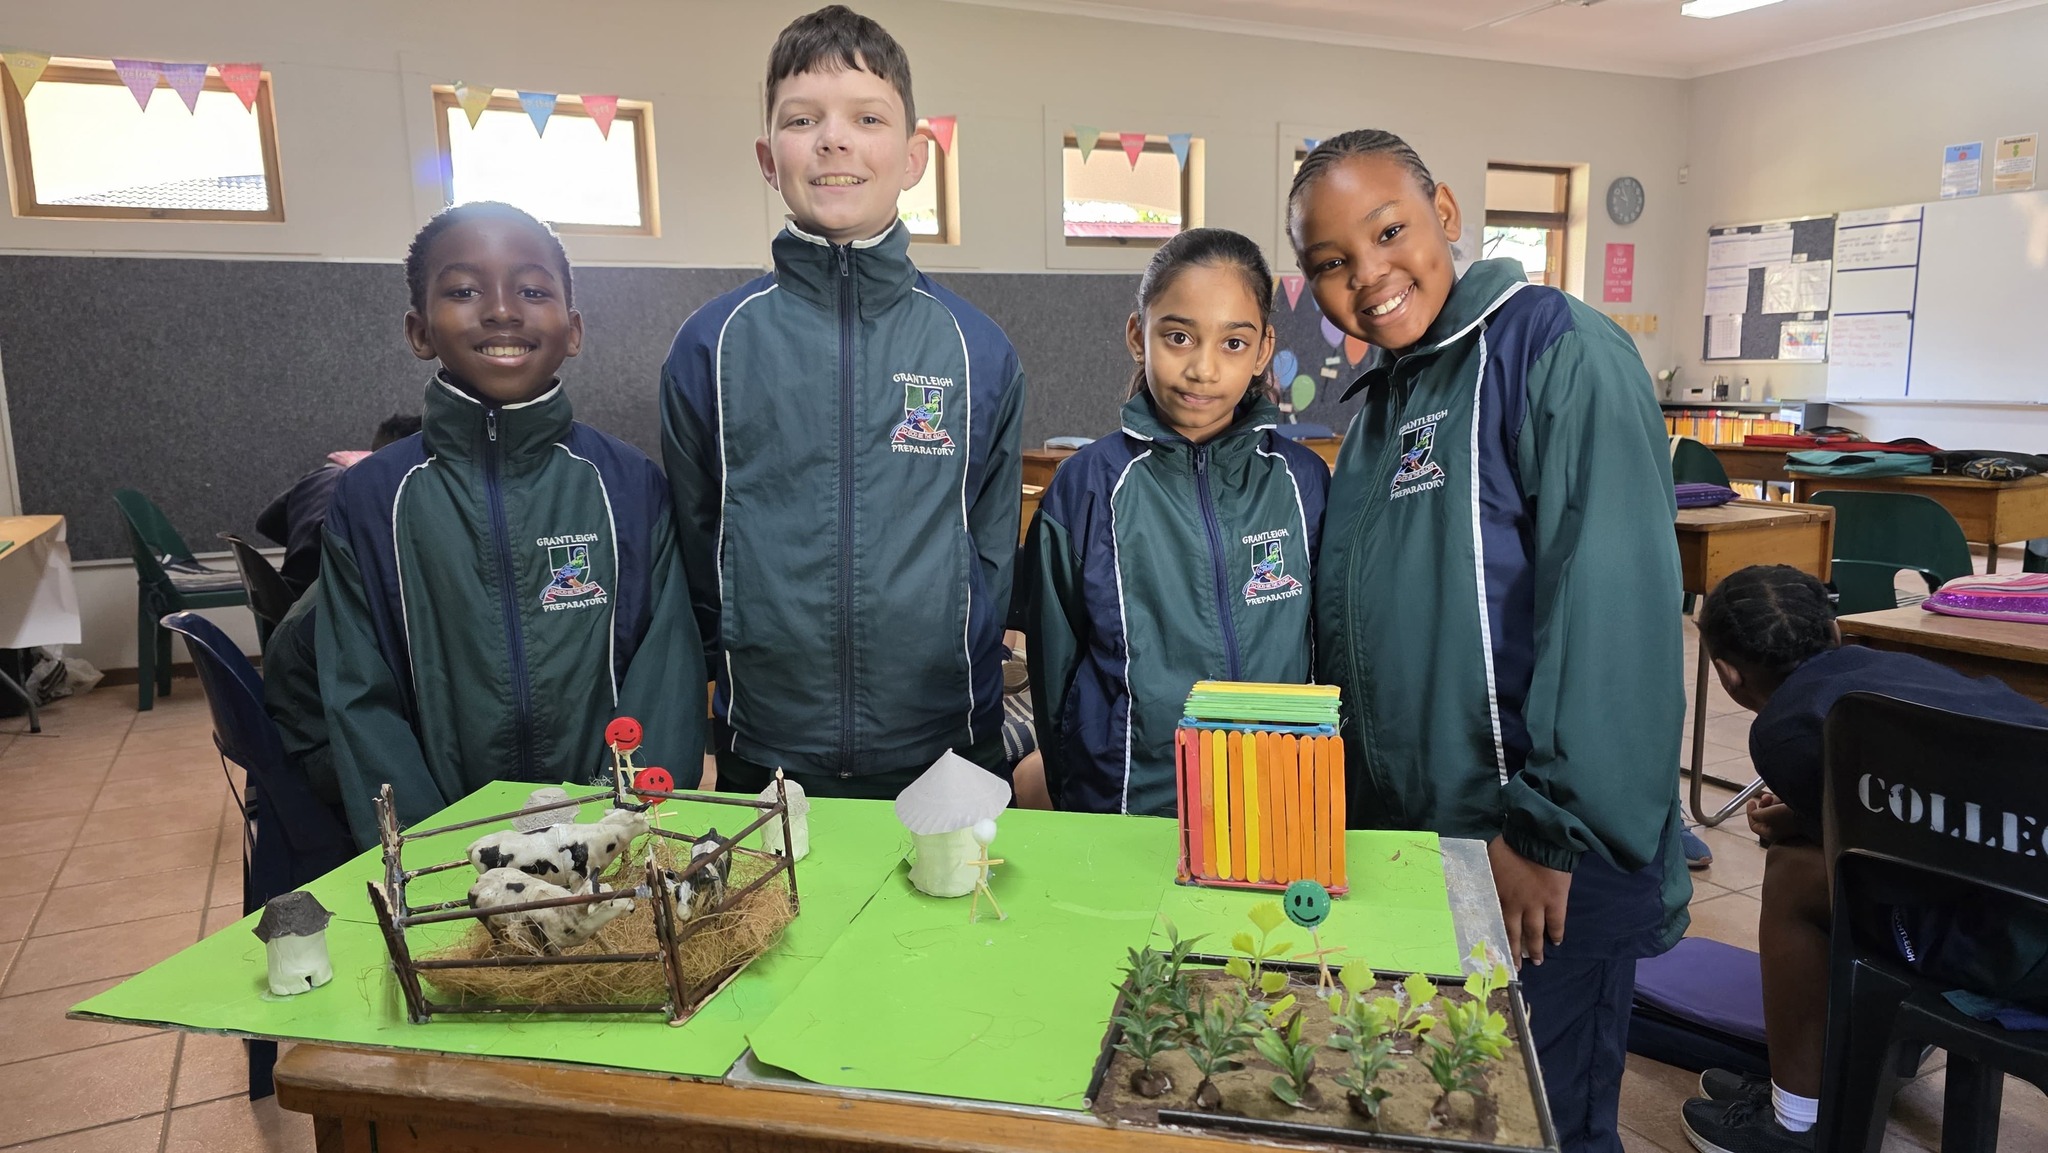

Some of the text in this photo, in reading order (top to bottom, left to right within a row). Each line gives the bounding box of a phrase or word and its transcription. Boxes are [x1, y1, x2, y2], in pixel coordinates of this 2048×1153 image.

[1289, 279, 1299, 292] T
[892, 372, 954, 387] GRANTLEIGH
[891, 444, 955, 456] PREPARATORY
[1390, 477, 1446, 501] PREPARATORY
[536, 533, 598, 546] GRANTLEIGH
[1242, 528, 1290, 545] GRANTLEIGH
[542, 596, 608, 612] PREPARATORY
[1245, 587, 1303, 606] PREPARATORY
[1858, 773, 2048, 857] COLLE
